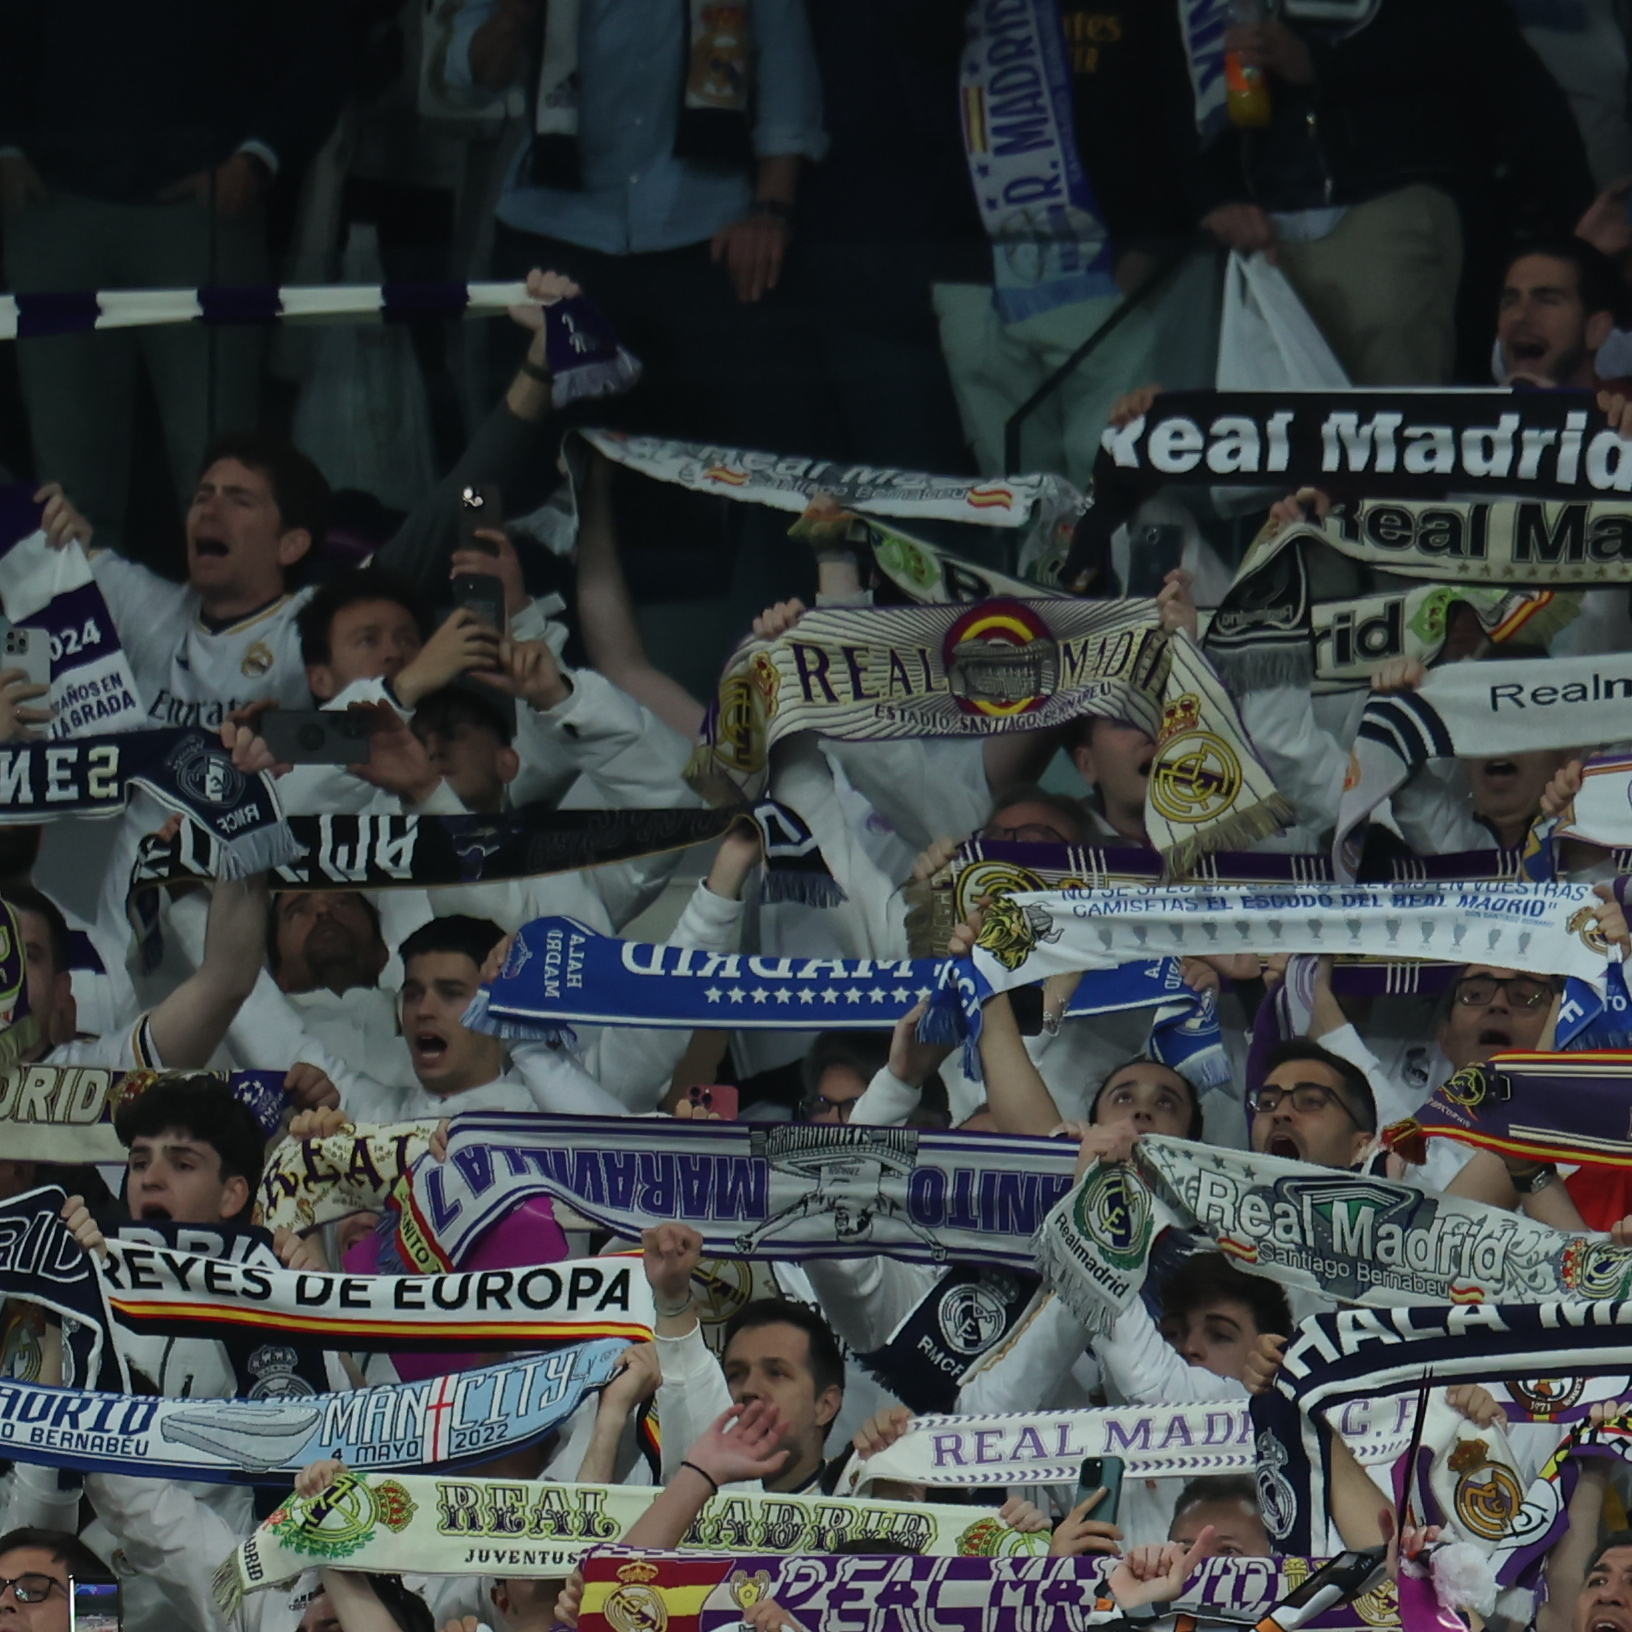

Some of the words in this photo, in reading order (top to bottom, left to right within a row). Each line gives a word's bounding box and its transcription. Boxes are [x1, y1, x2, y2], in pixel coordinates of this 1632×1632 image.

[71, 690, 137, 728] GRADA
[1240, 893, 1333, 912] ESCUDO
[1341, 892, 1378, 911] DEL
[1387, 892, 1451, 912] REAL
[1196, 1169, 1317, 1253] Real
[1328, 1195, 1513, 1284] Madrid
[1053, 1211, 1130, 1301] Realmadrid
[1256, 1236, 1351, 1283] Santiago
[102, 1246, 273, 1302] REYES
[296, 1276, 370, 1309] DE
[394, 1268, 632, 1315] EUROPA
[29, 1426, 150, 1456] BERNABÉU
[355, 1441, 420, 1461] MAYO
[454, 1426, 509, 1450] 2022
[932, 1411, 1090, 1468] REAL
[435, 1482, 619, 1540] REAL
[464, 1547, 581, 1565] JUVENTUS
